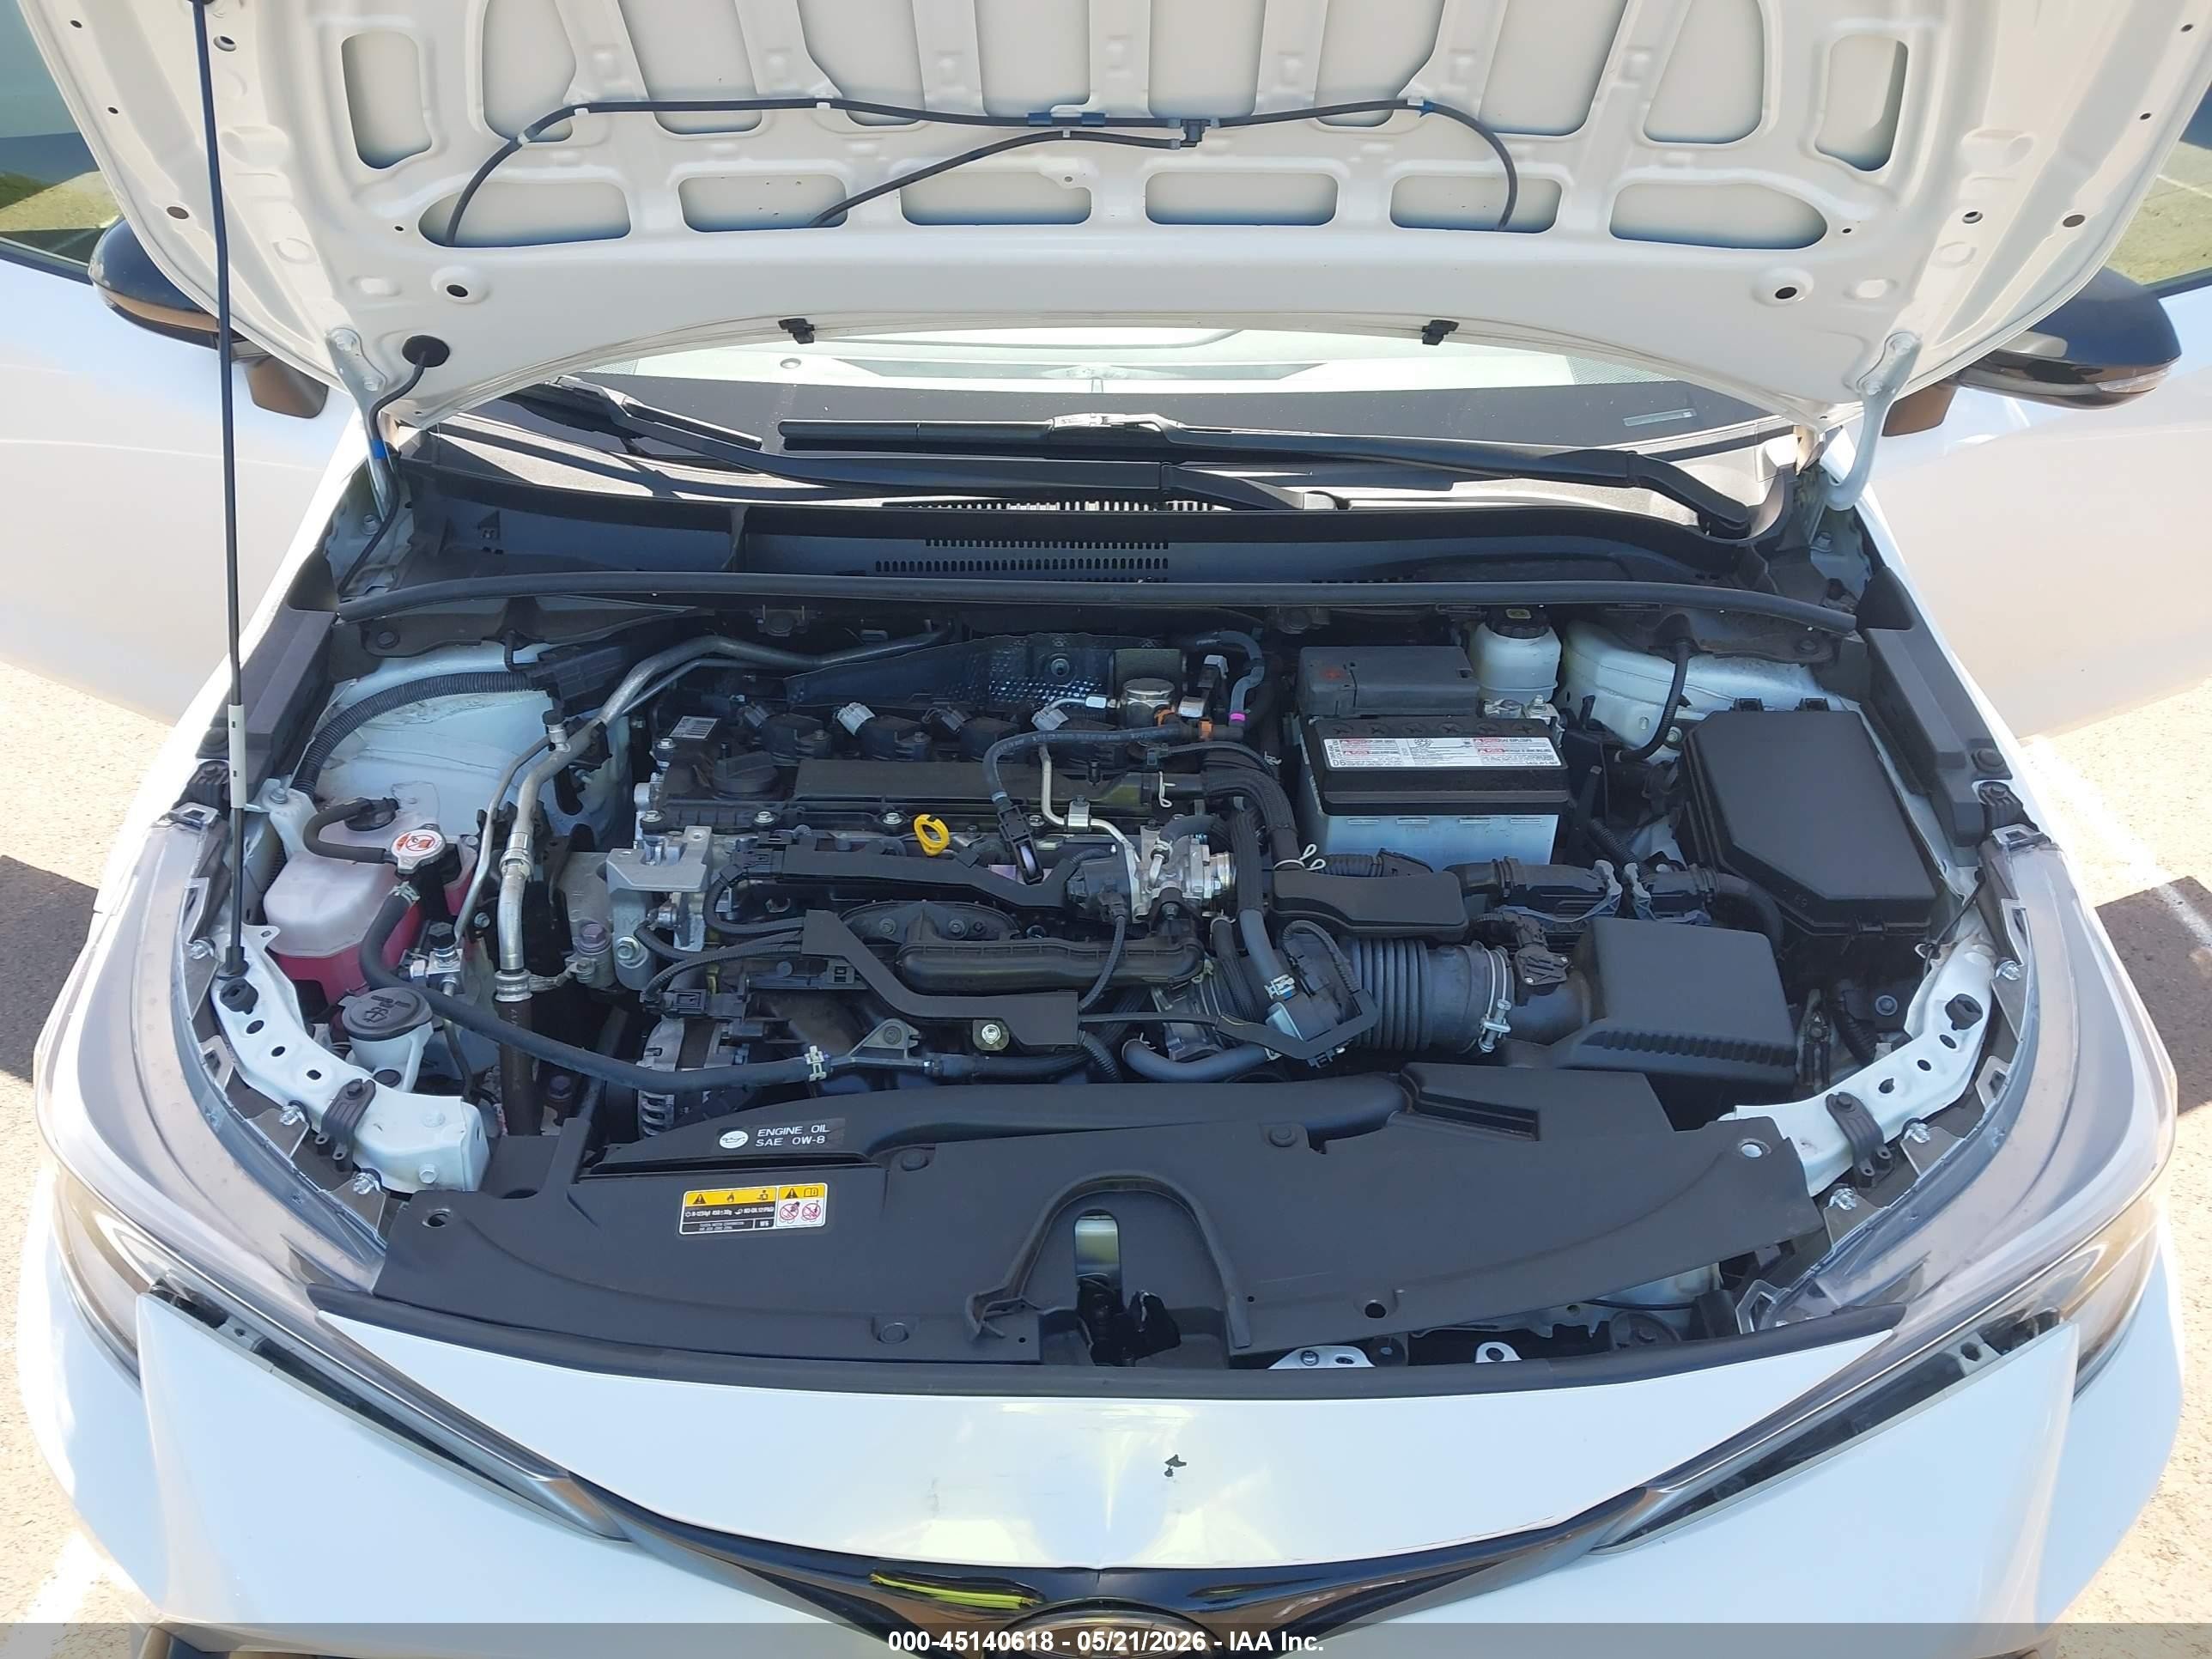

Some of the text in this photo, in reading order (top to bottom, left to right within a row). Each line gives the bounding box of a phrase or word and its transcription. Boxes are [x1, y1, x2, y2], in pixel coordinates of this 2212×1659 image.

[757, 1124, 830, 1137] ENGINE OIL
[755, 1137, 784, 1147] SAE
